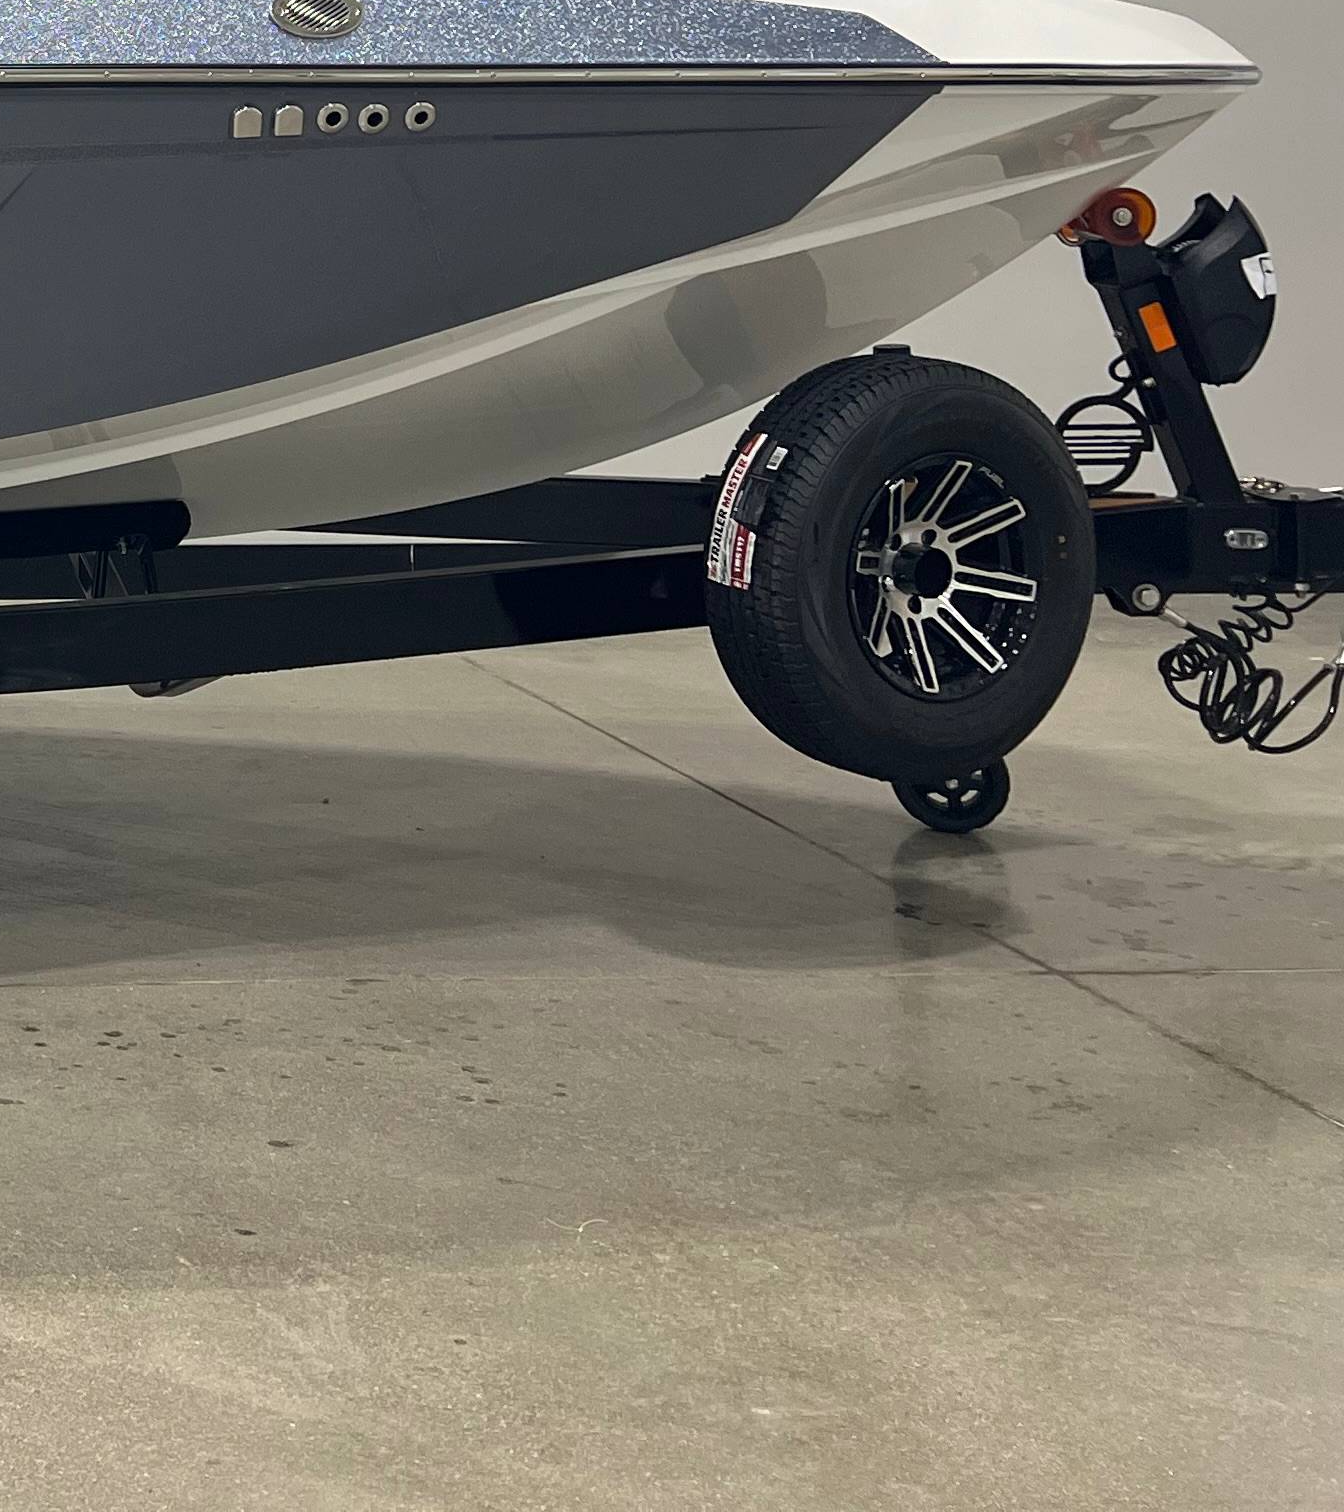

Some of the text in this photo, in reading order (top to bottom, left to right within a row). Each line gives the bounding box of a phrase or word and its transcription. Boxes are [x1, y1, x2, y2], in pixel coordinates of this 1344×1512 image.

[978, 466, 1004, 489] FUEL
[710, 458, 748, 563] TRAILER MASTER
